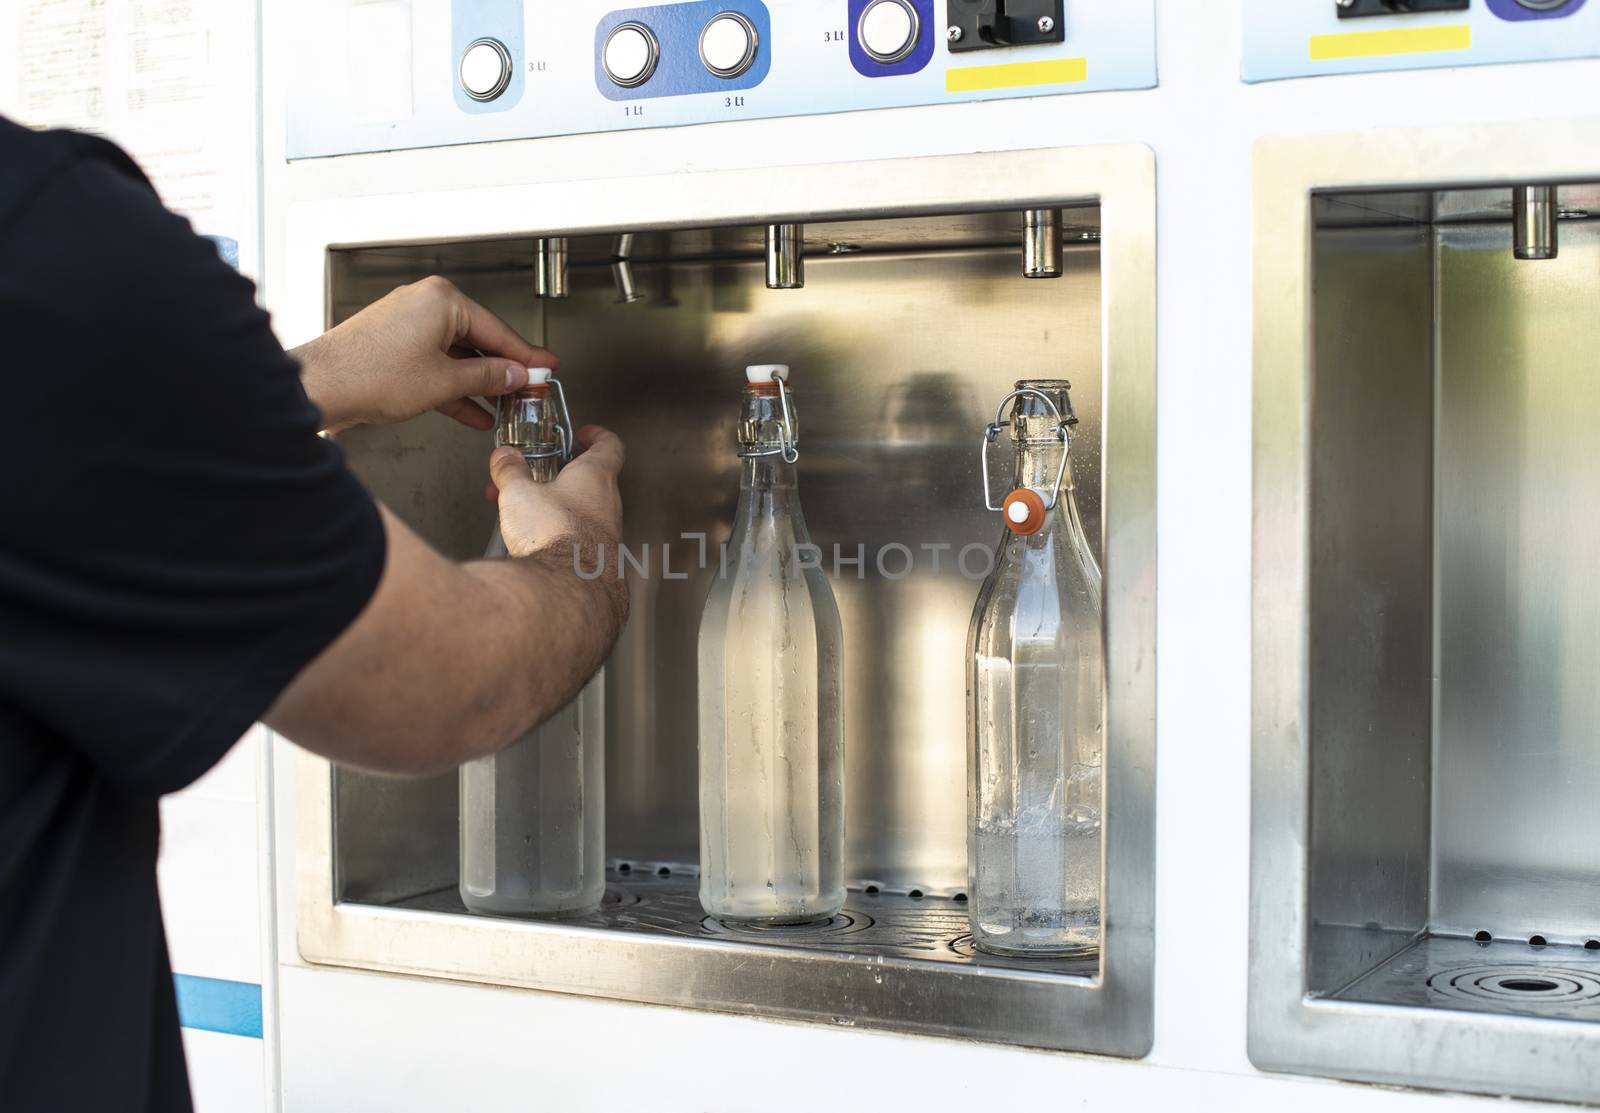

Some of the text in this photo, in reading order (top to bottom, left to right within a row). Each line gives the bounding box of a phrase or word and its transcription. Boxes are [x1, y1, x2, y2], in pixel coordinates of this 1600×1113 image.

[824, 30, 844, 42] 3 Lt
[528, 60, 546, 72] 3 Lt
[724, 96, 744, 107] 3 Lt
[625, 105, 643, 117] 1 Lt
